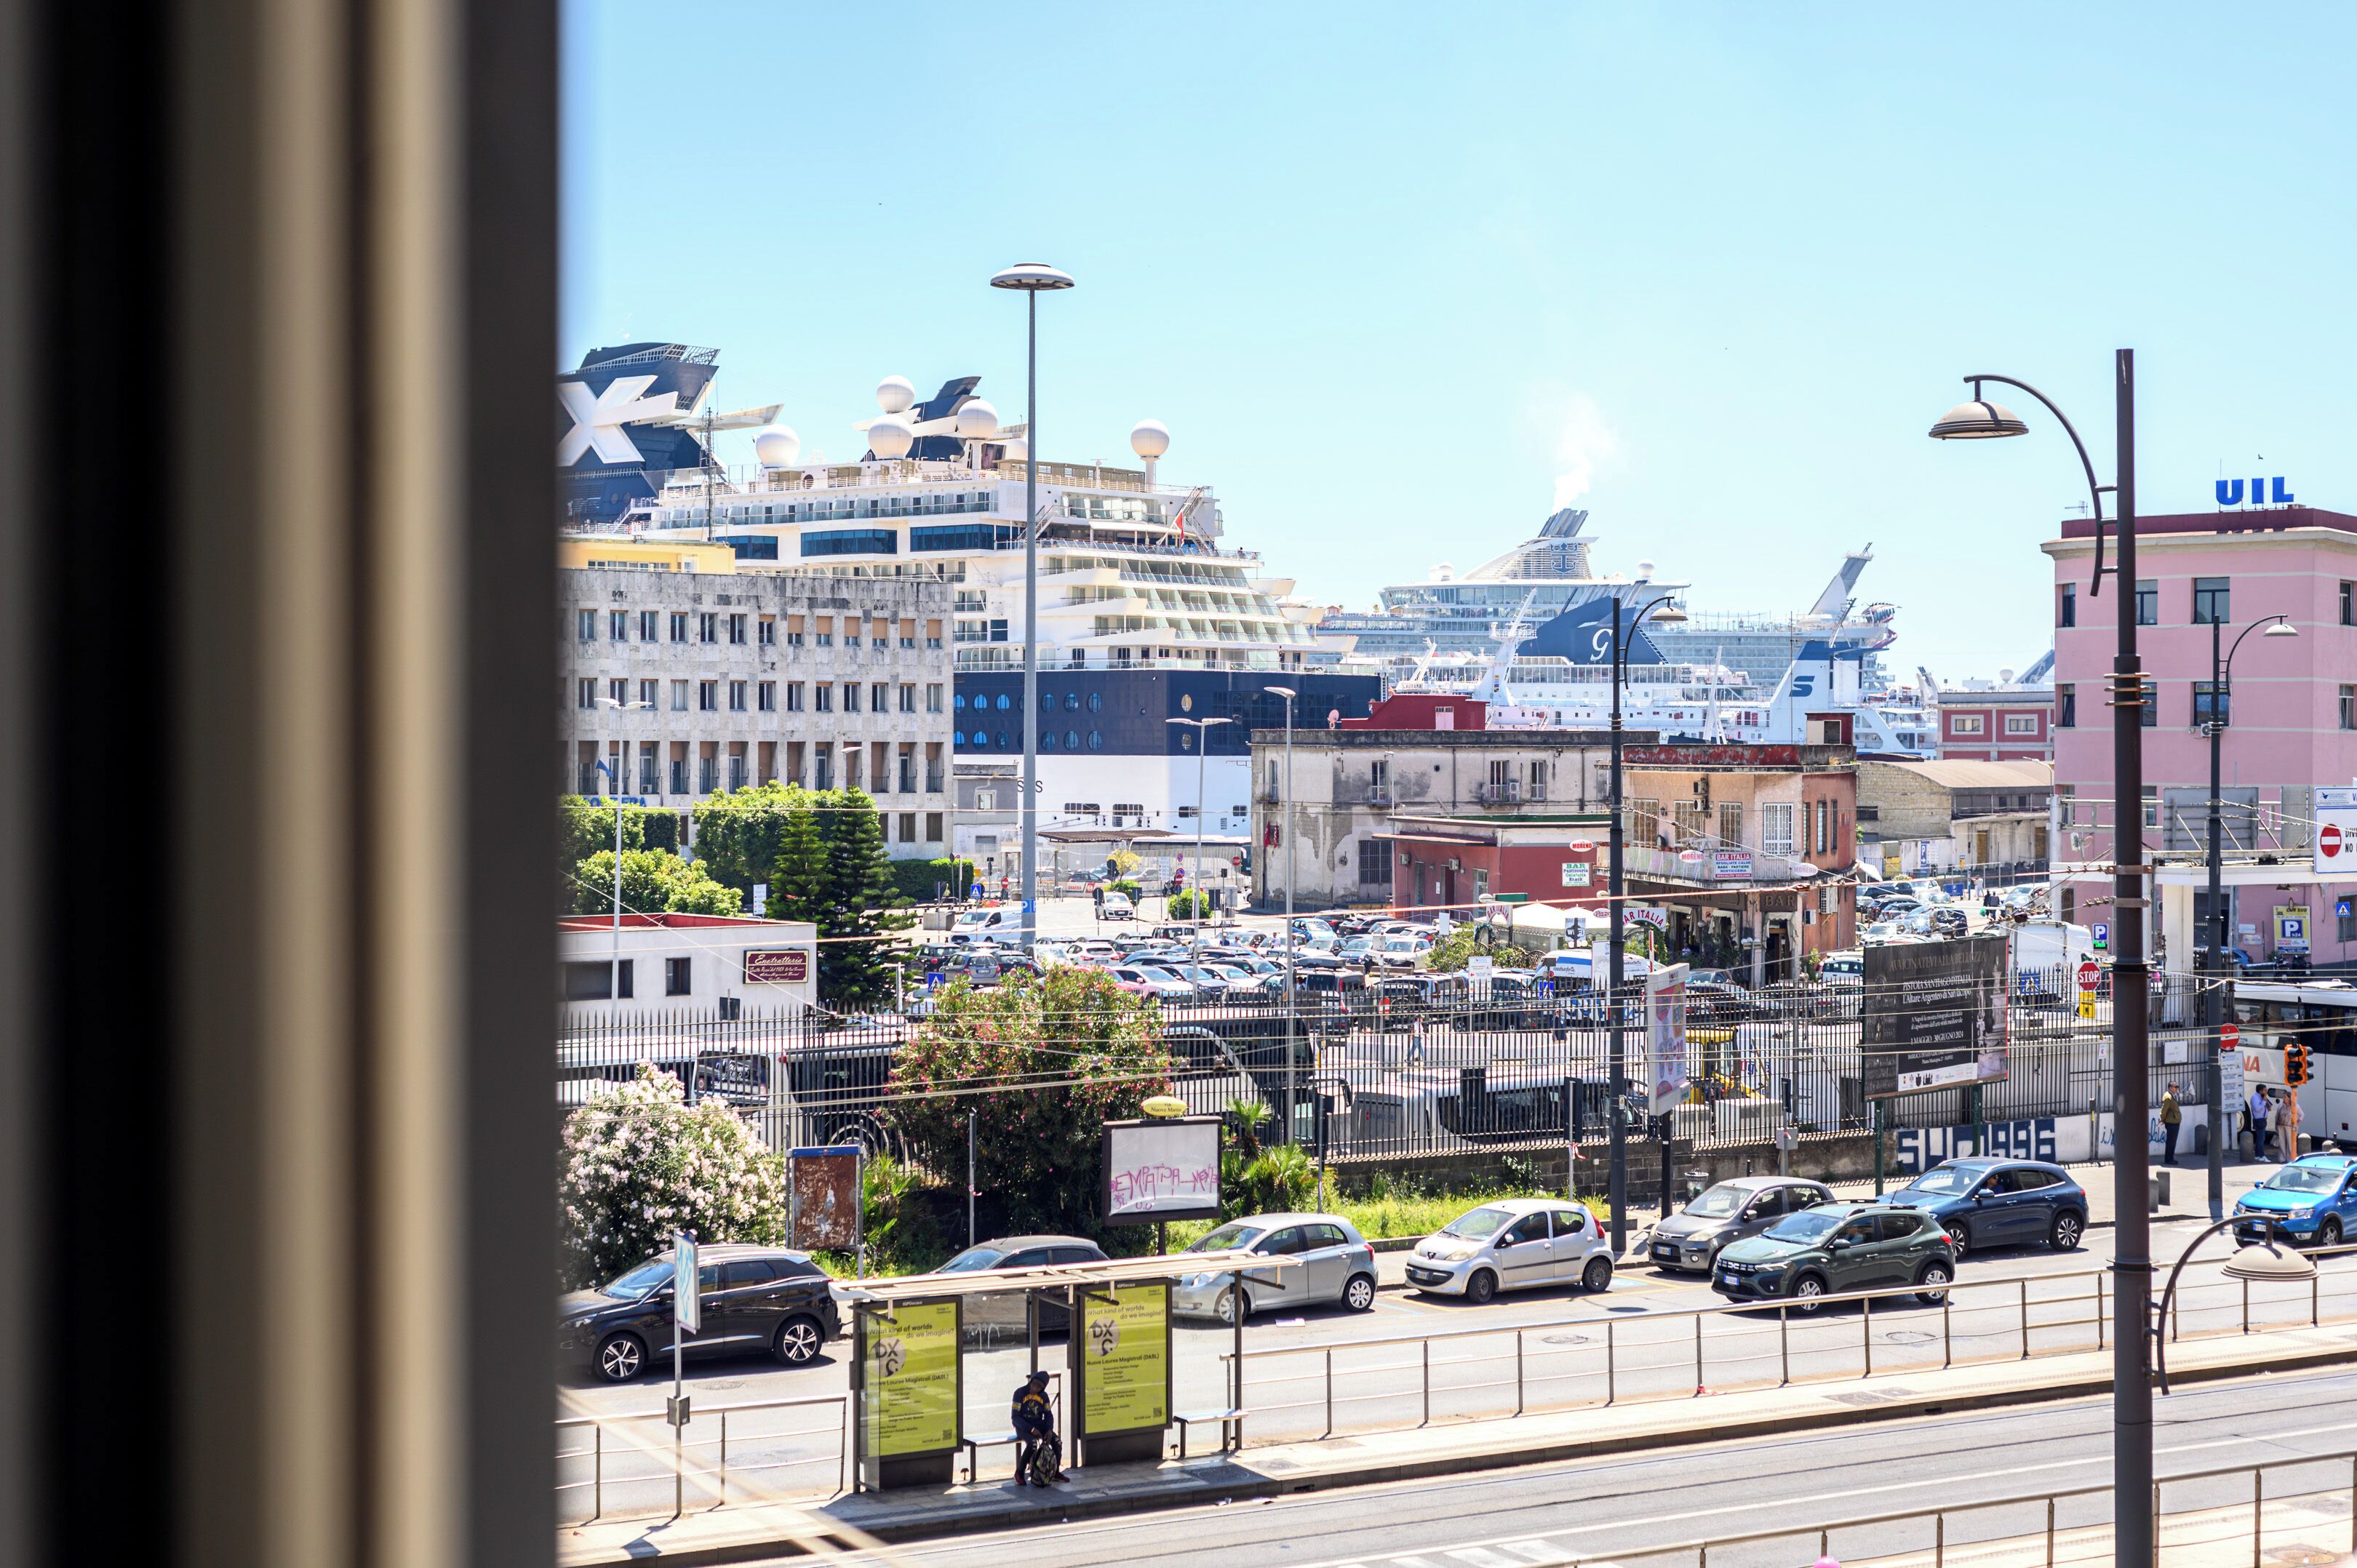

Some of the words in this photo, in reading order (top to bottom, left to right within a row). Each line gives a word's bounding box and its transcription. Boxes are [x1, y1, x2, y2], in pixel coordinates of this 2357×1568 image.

[2216, 476, 2294, 505] UIL
[2345, 844, 2353, 853] NO
[1765, 895, 1795, 907] BAR
[1622, 911, 1635, 925] AR
[1638, 910, 1664, 927] ITALIA
[2095, 926, 2106, 938] P
[2285, 921, 2300, 937] P
[754, 954, 803, 964] Enotrattoria
[1938, 954, 1954, 966] ALLA
[2078, 971, 2099, 982] STOP
[1903, 993, 1921, 1004] L'Altare
[1921, 991, 1942, 1004] Argenteo
[1942, 990, 1947, 999] di
[1947, 989, 1955, 998] San
[1138, 1310, 1165, 1318] imagine?
[925, 1328, 954, 1337] imagine?
[905, 1375, 930, 1383] Magistrali
